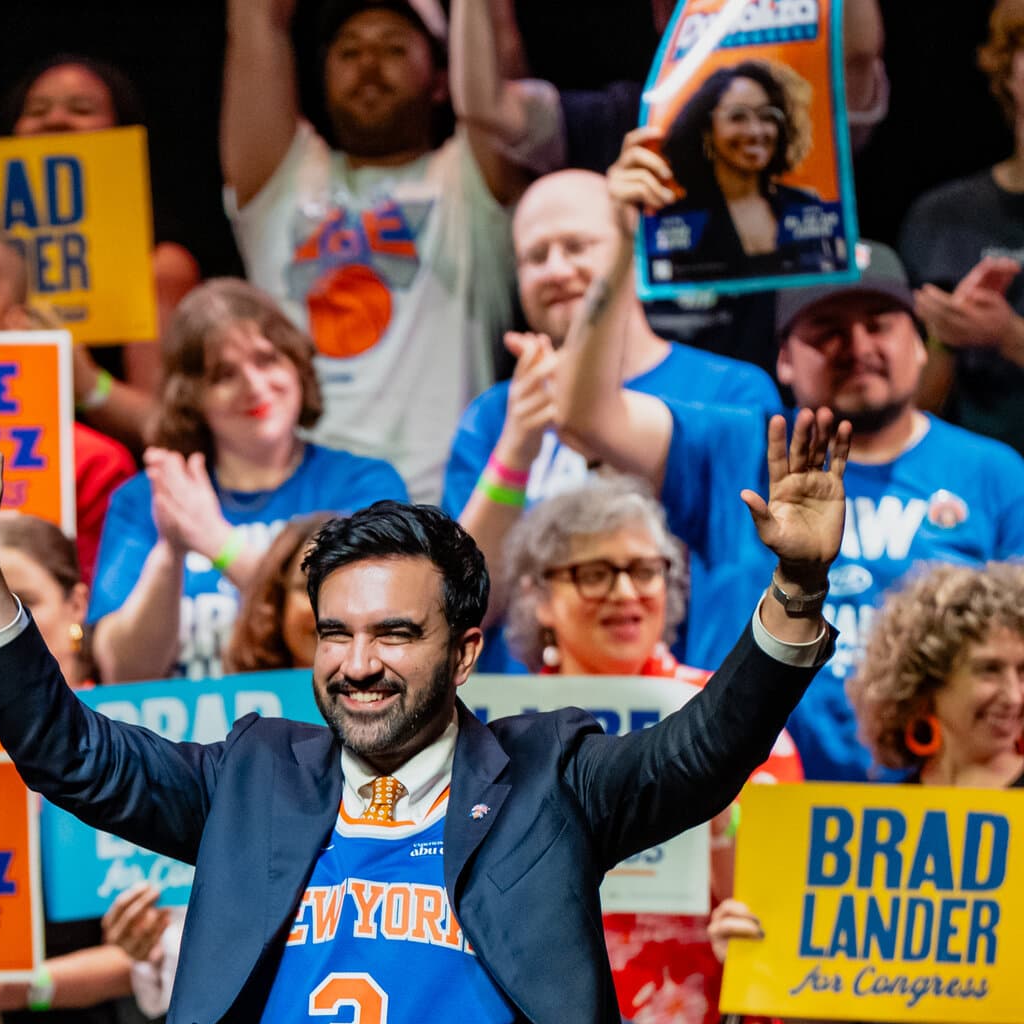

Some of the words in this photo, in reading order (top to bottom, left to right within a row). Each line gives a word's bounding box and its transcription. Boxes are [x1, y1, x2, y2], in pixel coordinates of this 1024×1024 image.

[807, 807, 1010, 892] BRAD
[286, 878, 347, 947] EW
[799, 893, 1001, 965] LANDER
[789, 965, 842, 996] for
[854, 967, 988, 1008] Congress
